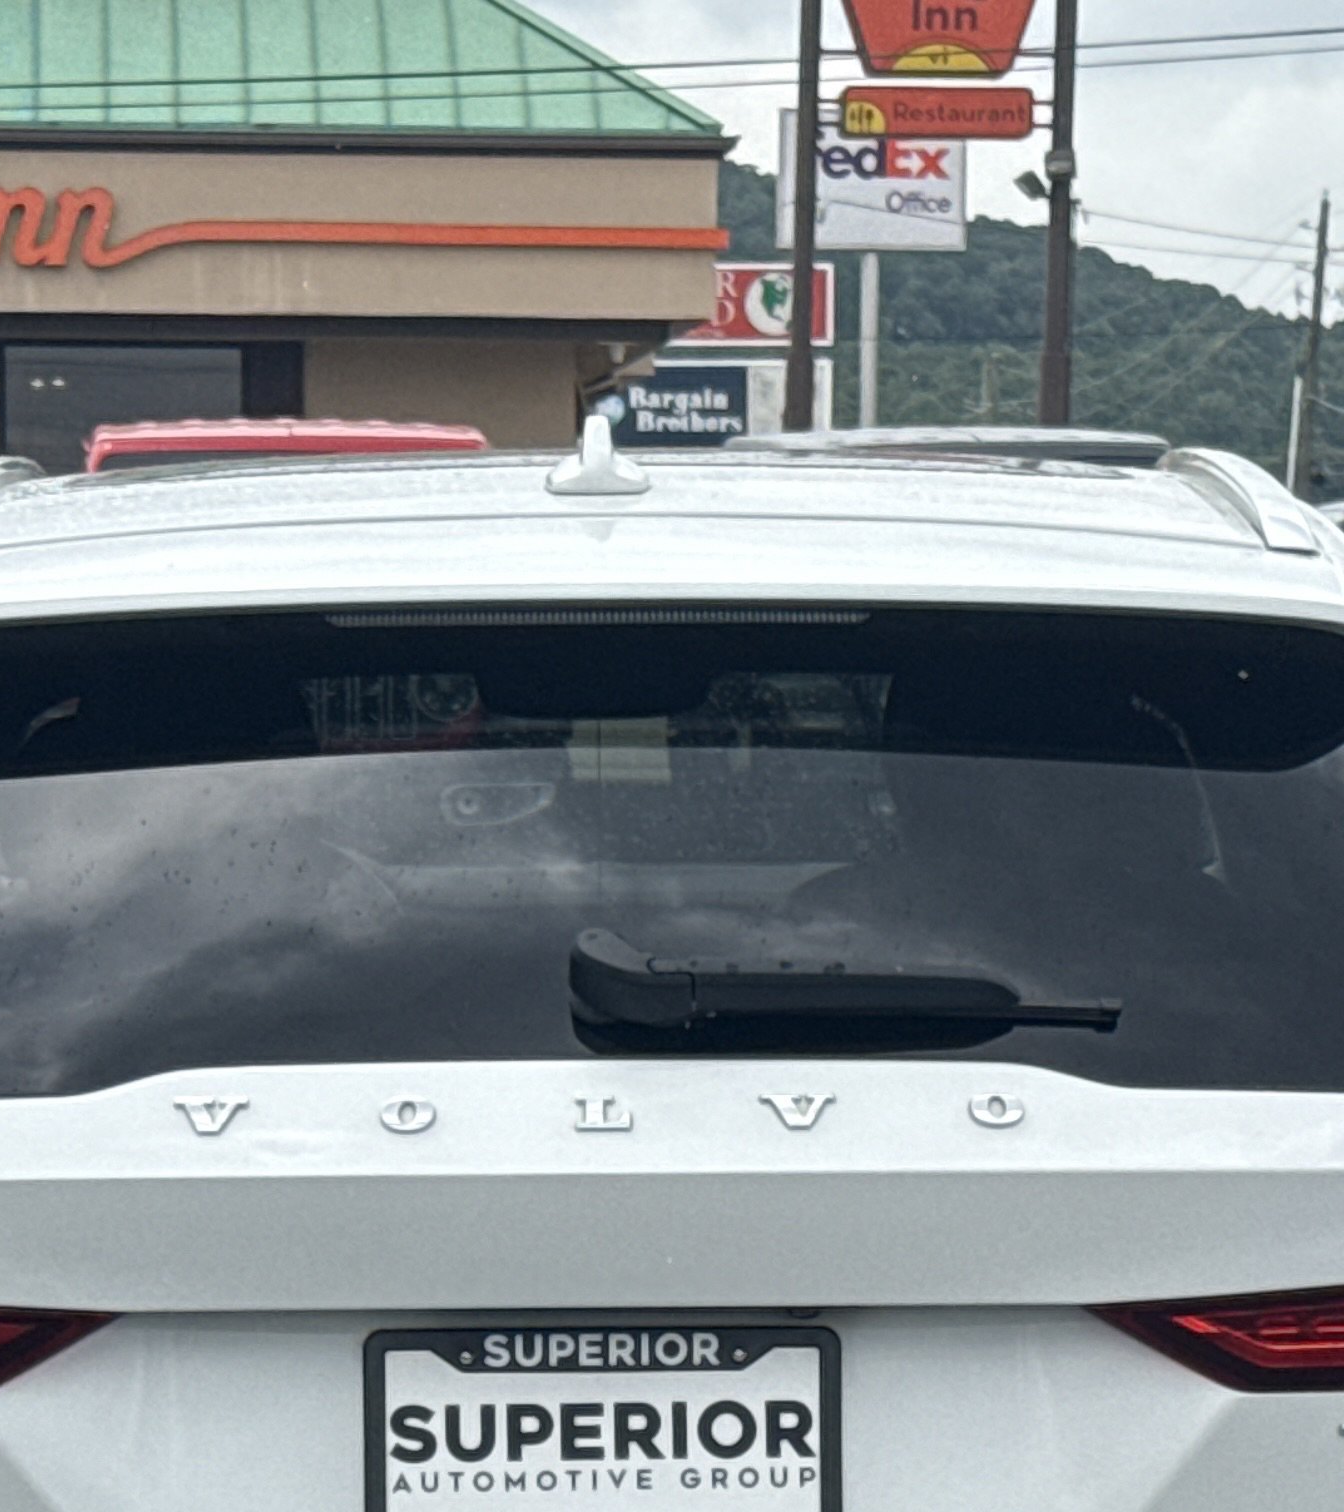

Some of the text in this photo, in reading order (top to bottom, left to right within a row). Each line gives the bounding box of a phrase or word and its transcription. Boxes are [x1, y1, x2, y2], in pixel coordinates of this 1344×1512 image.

[912, 0, 978, 31] Inn
[894, 102, 1026, 122] Restaurant
[817, 129, 951, 180] edEx
[886, 191, 953, 214] Office
[628, 386, 729, 415] Bargain
[637, 410, 743, 432] Brothers
[173, 1093, 1024, 1137] VOLVO
[483, 1331, 721, 1367] SUPERIOR
[389, 1400, 816, 1463] SUPERIOR
[392, 1466, 817, 1495] AUTOMOTIVE GROUP
